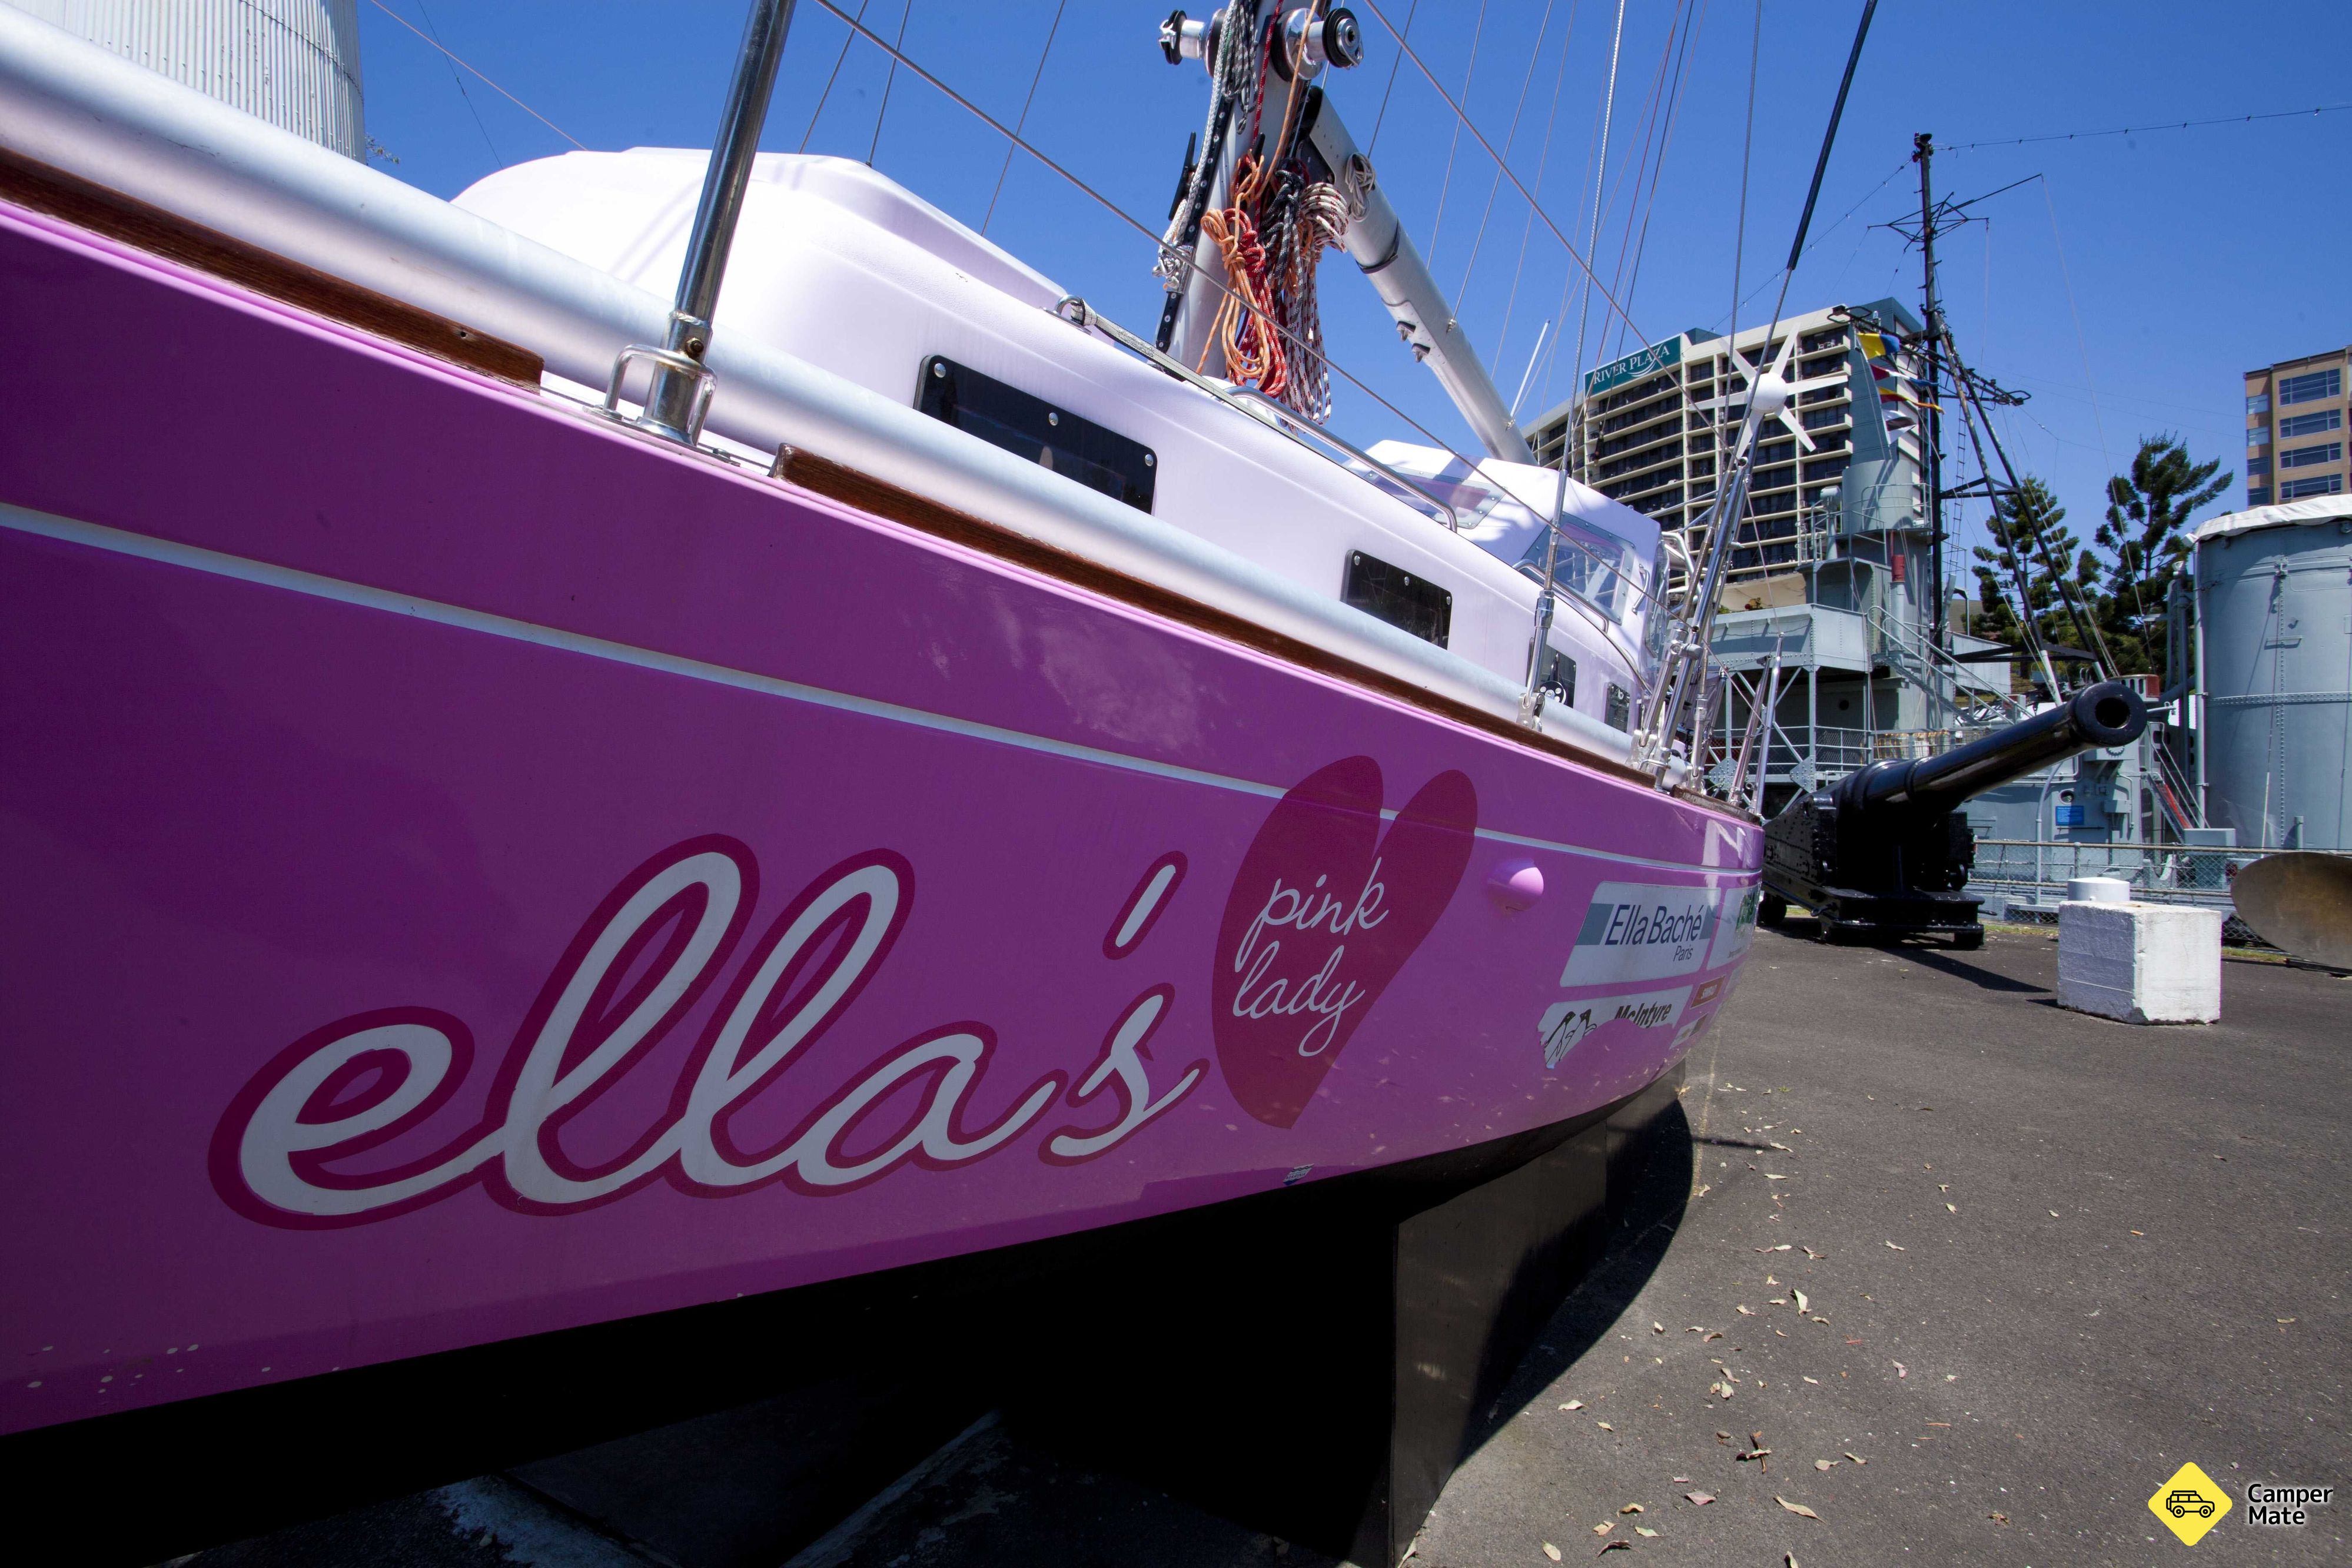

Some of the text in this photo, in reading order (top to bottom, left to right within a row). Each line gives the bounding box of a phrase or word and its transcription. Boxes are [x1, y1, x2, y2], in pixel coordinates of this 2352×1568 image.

[1593, 345, 1670, 385] RIVER PLAZA
[1234, 856, 1390, 974] pink
[1604, 904, 1649, 945] Ella
[1646, 905, 1704, 944] Baché
[1673, 945, 1693, 962] Paris
[1232, 940, 1366, 1057] lady
[1614, 1001, 1672, 1029] McIntyre
[241, 851, 1201, 1217] ella's
